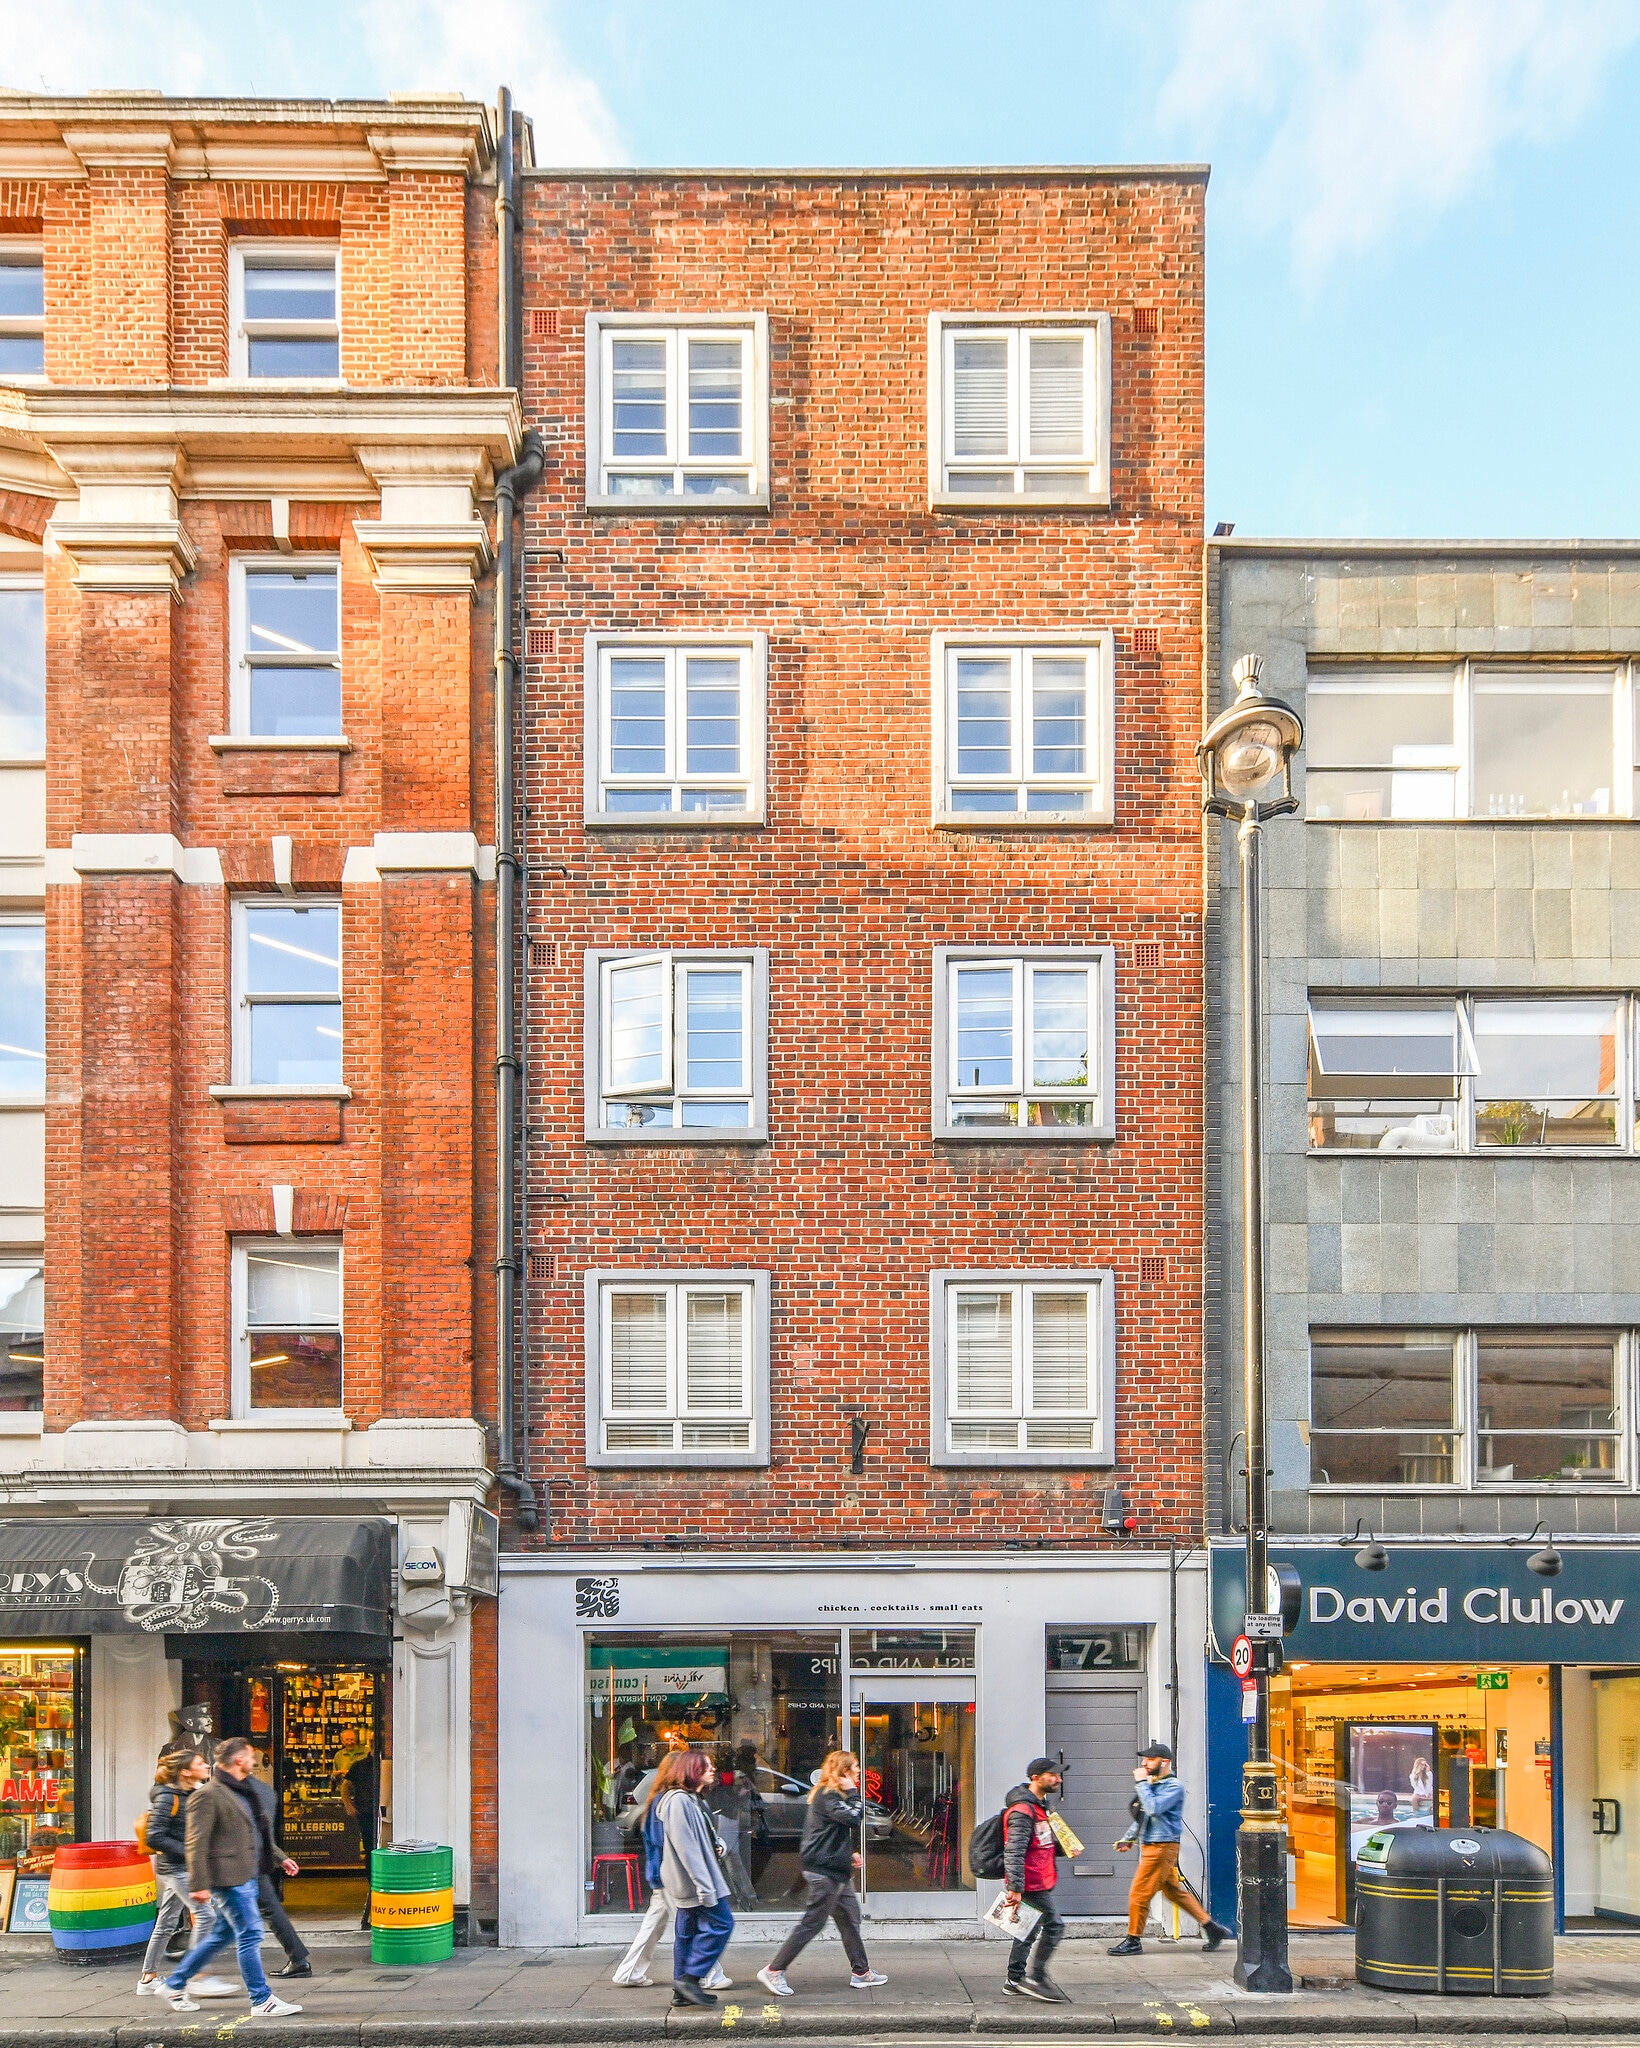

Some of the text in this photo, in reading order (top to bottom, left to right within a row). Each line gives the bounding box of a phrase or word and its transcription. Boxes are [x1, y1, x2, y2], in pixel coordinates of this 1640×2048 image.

[1255, 1530, 1265, 1541] 2
[405, 1561, 437, 1570] SECOM
[183, 1566, 195, 1601] KRAKEN
[14, 1595, 82, 1603] SPIRITS
[817, 1604, 860, 1612] chicken
[870, 1603, 920, 1611] cocktails
[929, 1603, 958, 1611] small
[1310, 1587, 1625, 1625] David Clulow
[1258, 1615, 1281, 1623] loading
[1072, 1639, 1112, 1665] 72
[1235, 1647, 1250, 1666] 20
[300, 1822, 345, 1832] LEGENDS
[123, 1896, 143, 1906] TIO
[388, 1907, 396, 1916] &
[398, 1904, 440, 1916] NEPHEW
